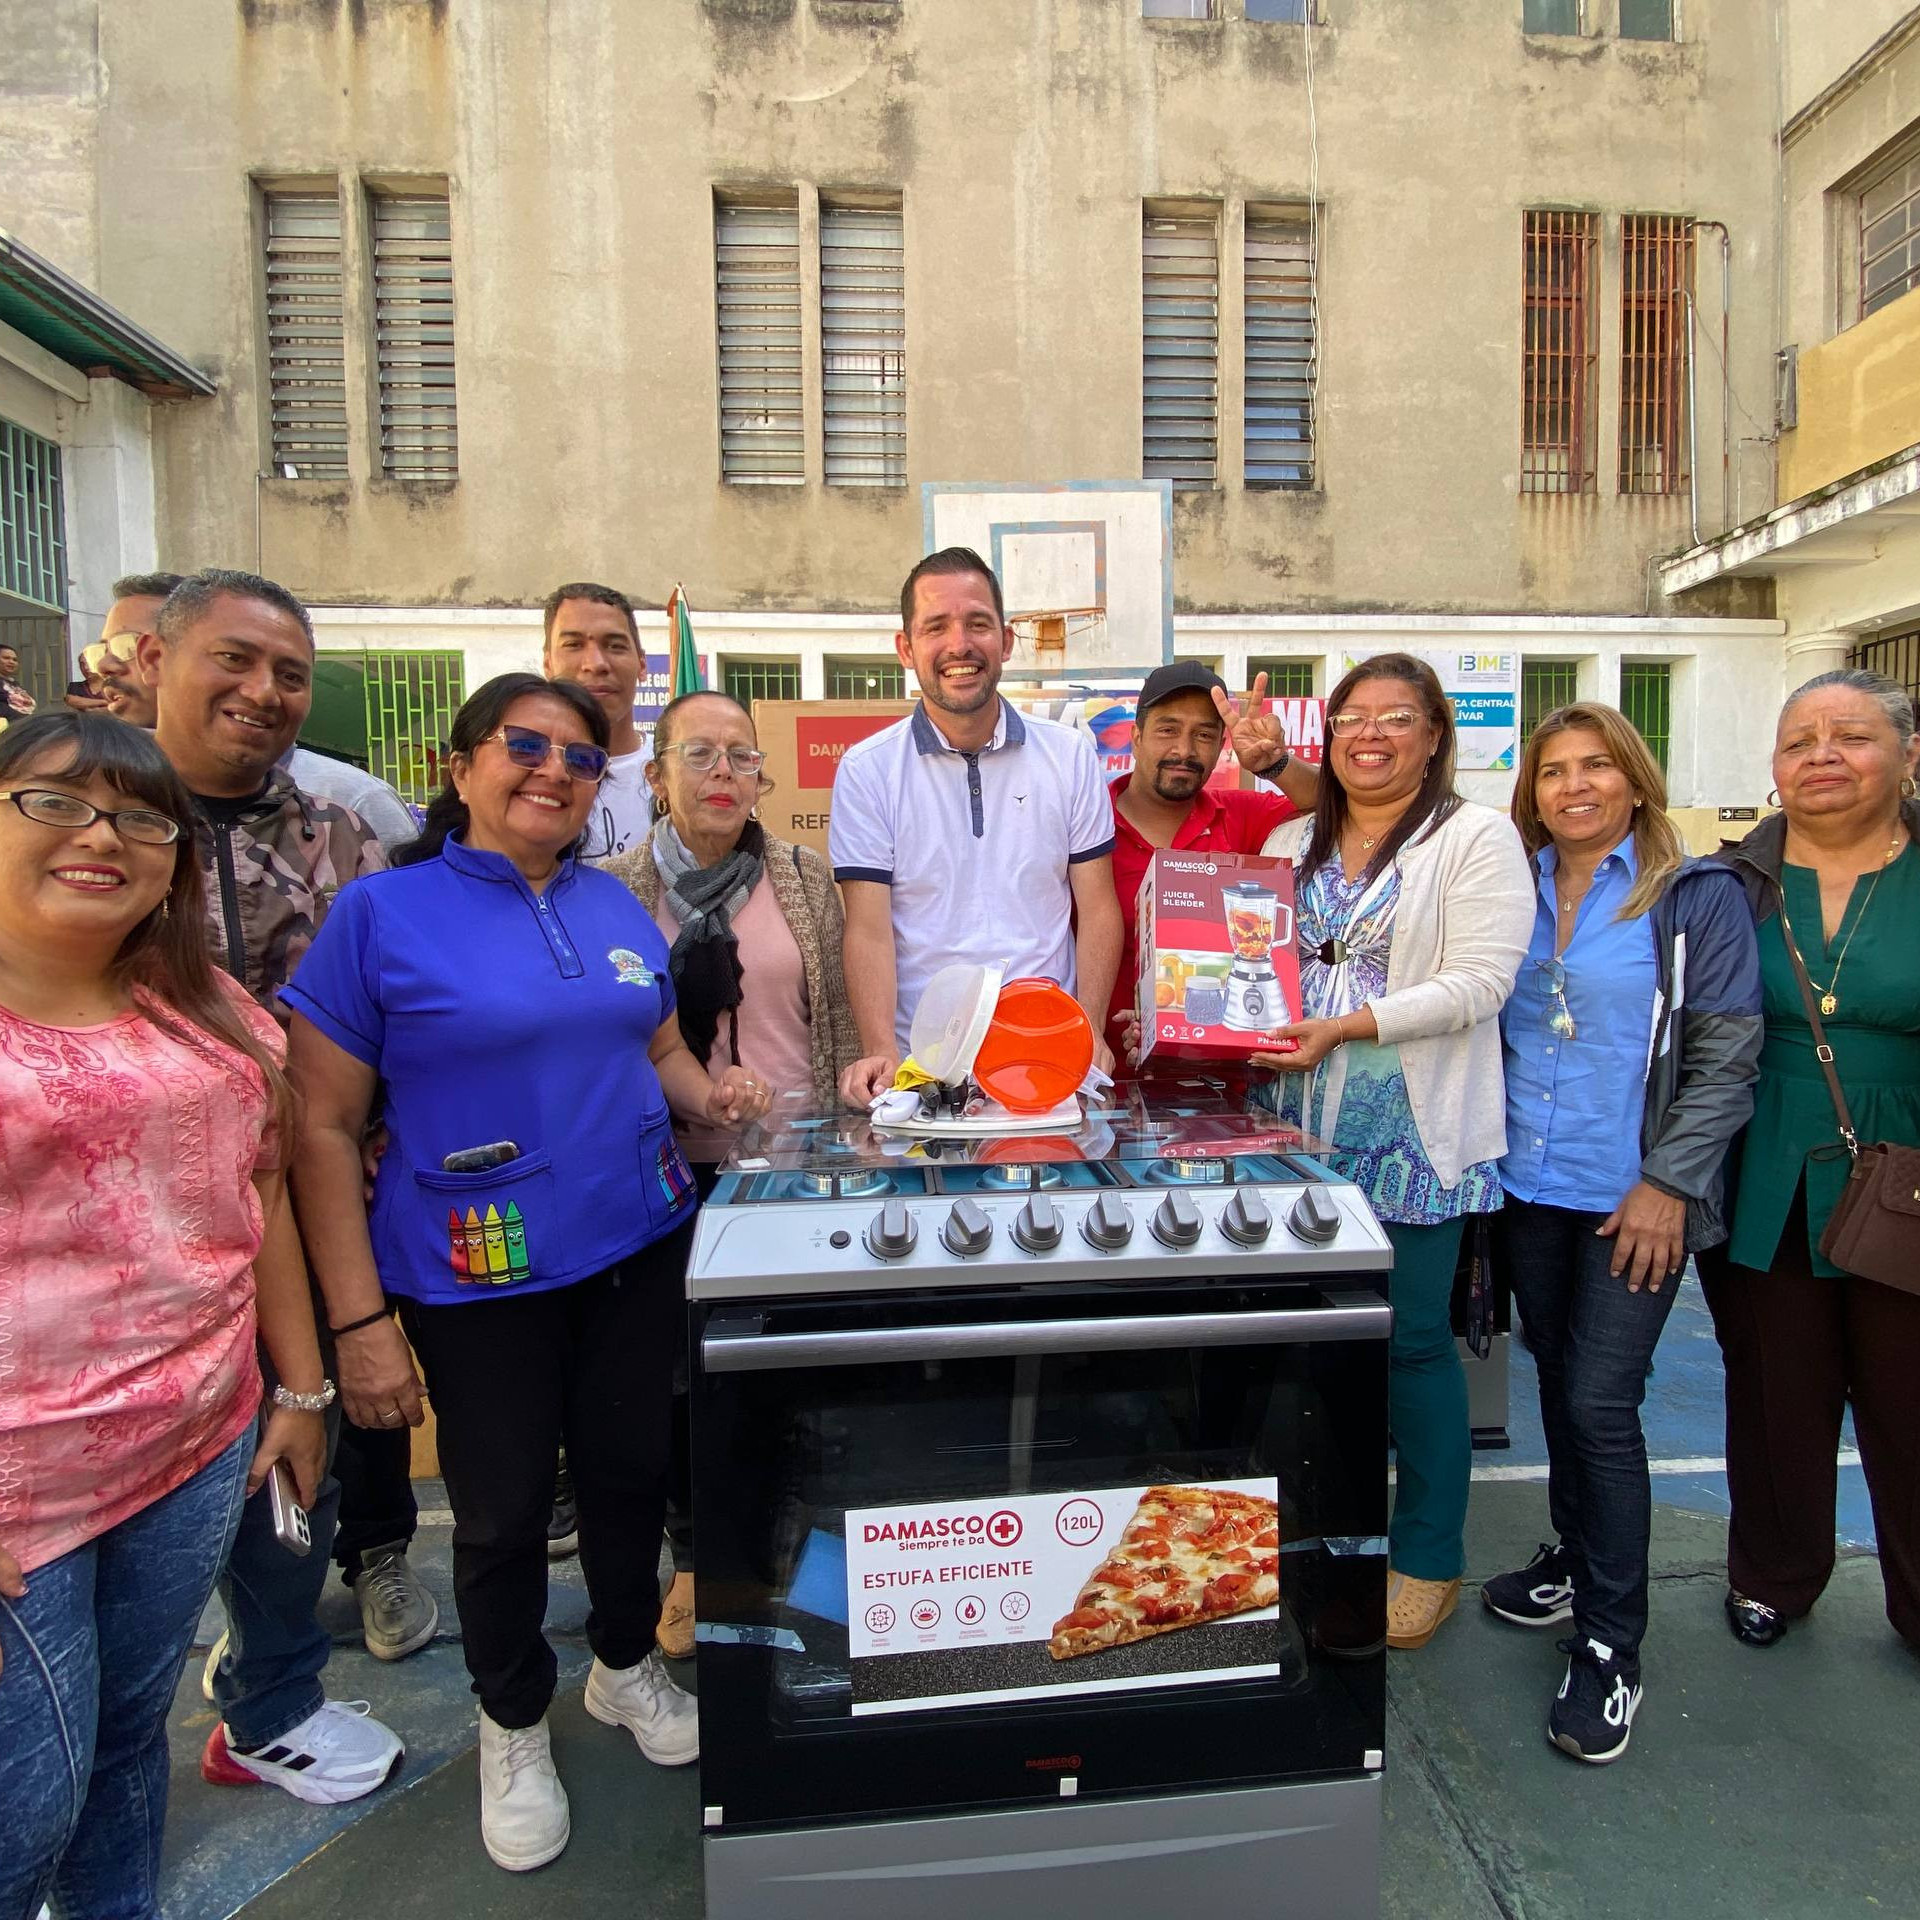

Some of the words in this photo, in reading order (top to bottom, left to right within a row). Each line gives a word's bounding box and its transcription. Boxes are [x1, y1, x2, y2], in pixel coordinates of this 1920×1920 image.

[1470, 699, 1516, 708] CENTRAL
[1272, 700, 1329, 746] MA
[809, 743, 853, 757] DAM
[792, 814, 829, 829] REF
[1163, 860, 1205, 870] DAMASCO
[1163, 890, 1195, 899] JUICER
[1163, 898, 1205, 908] BLENDER
[864, 1515, 984, 1543] DAMASCO
[1061, 1515, 1098, 1531] 120L
[899, 1538, 949, 1551] Siempre
[952, 1537, 965, 1547] te
[968, 1536, 985, 1546] Da
[864, 1569, 935, 1589] ESTUFA
[939, 1560, 1033, 1583] EFICIENTE
